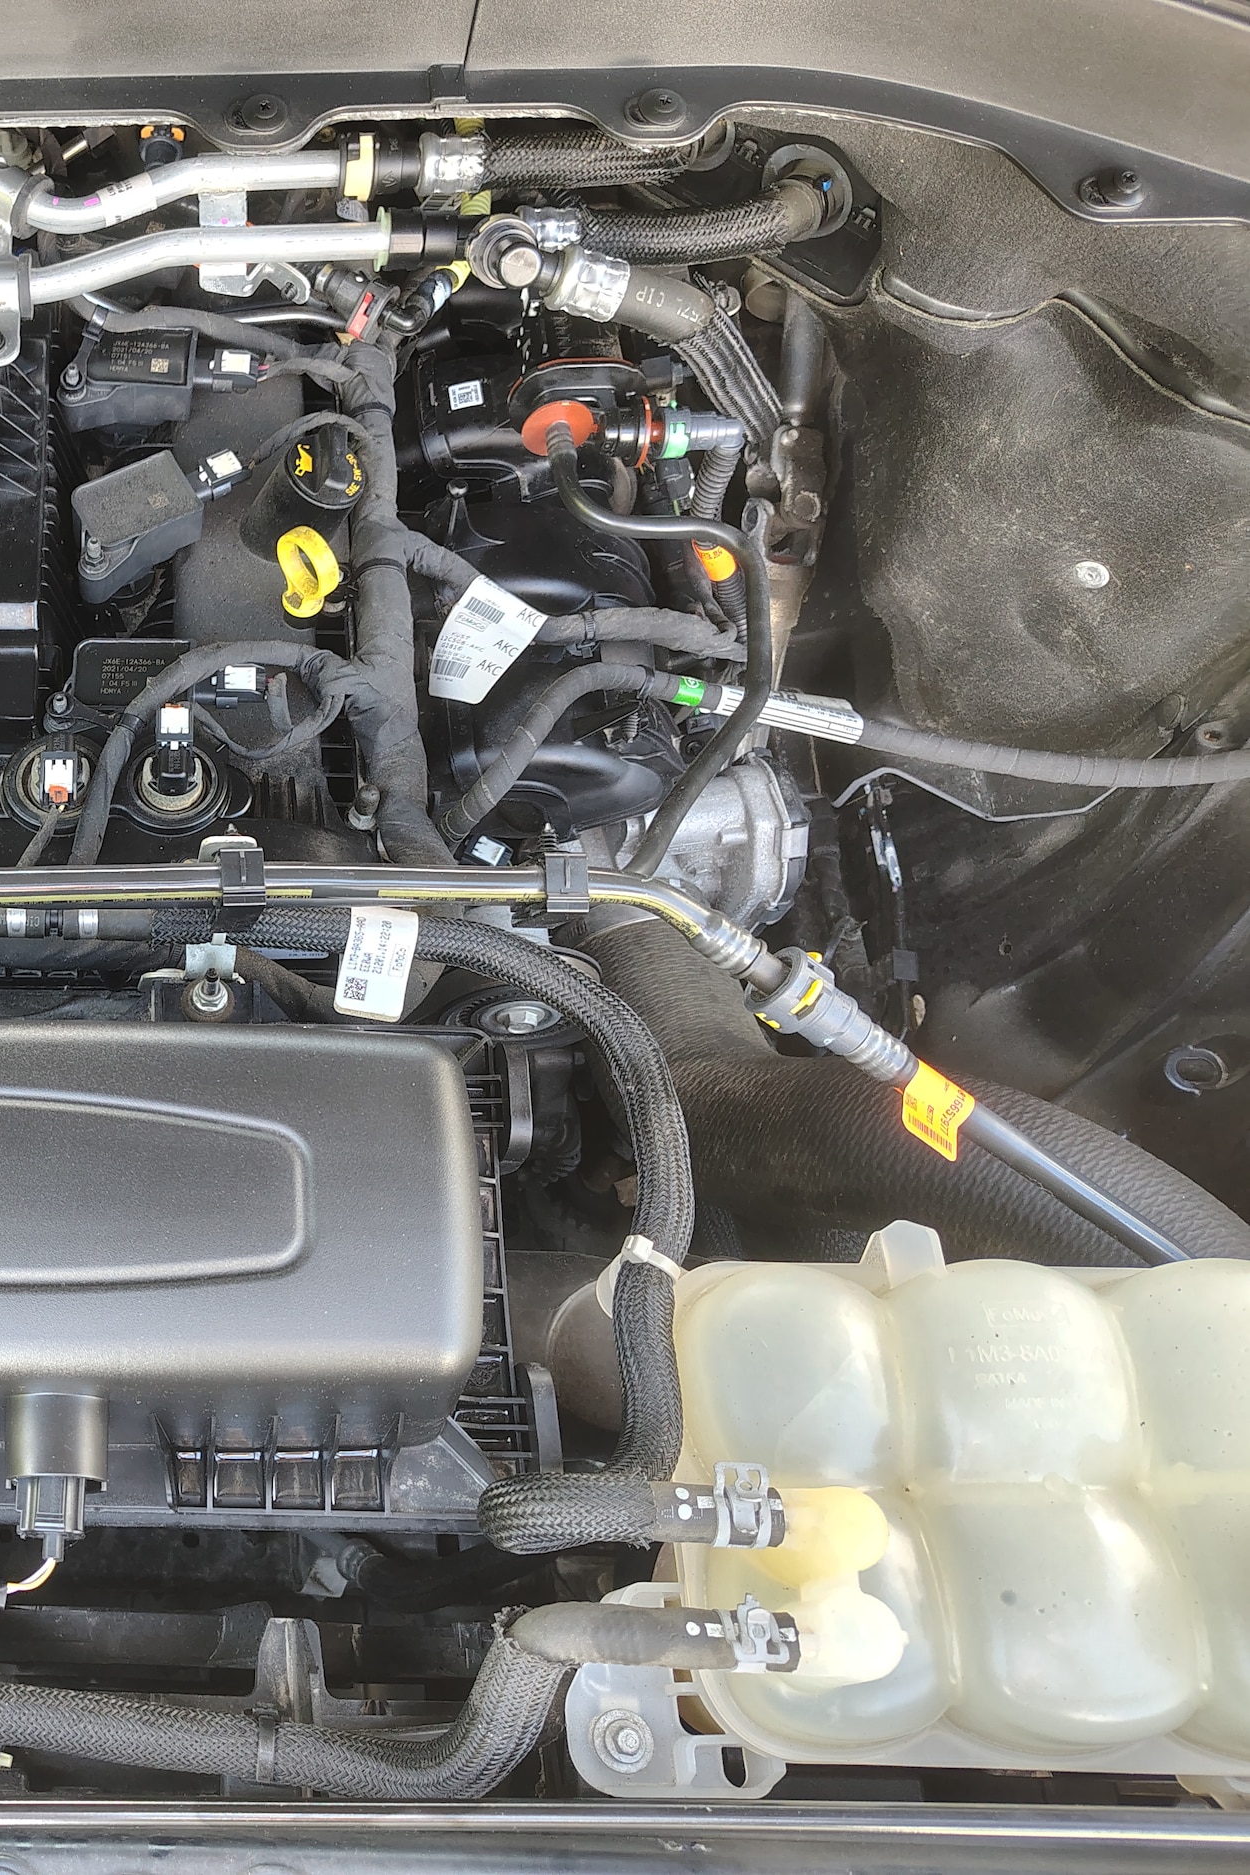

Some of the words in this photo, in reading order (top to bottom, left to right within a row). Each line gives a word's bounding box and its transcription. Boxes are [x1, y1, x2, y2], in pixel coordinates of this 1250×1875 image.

[344, 481, 361, 497] SAE
[516, 607, 543, 628] AKC
[492, 639, 520, 658] AKC
[102, 658, 166, 666] JX6E-12A366-BA
[475, 659, 503, 677] AKC
[392, 947, 407, 972] FoMoCo
